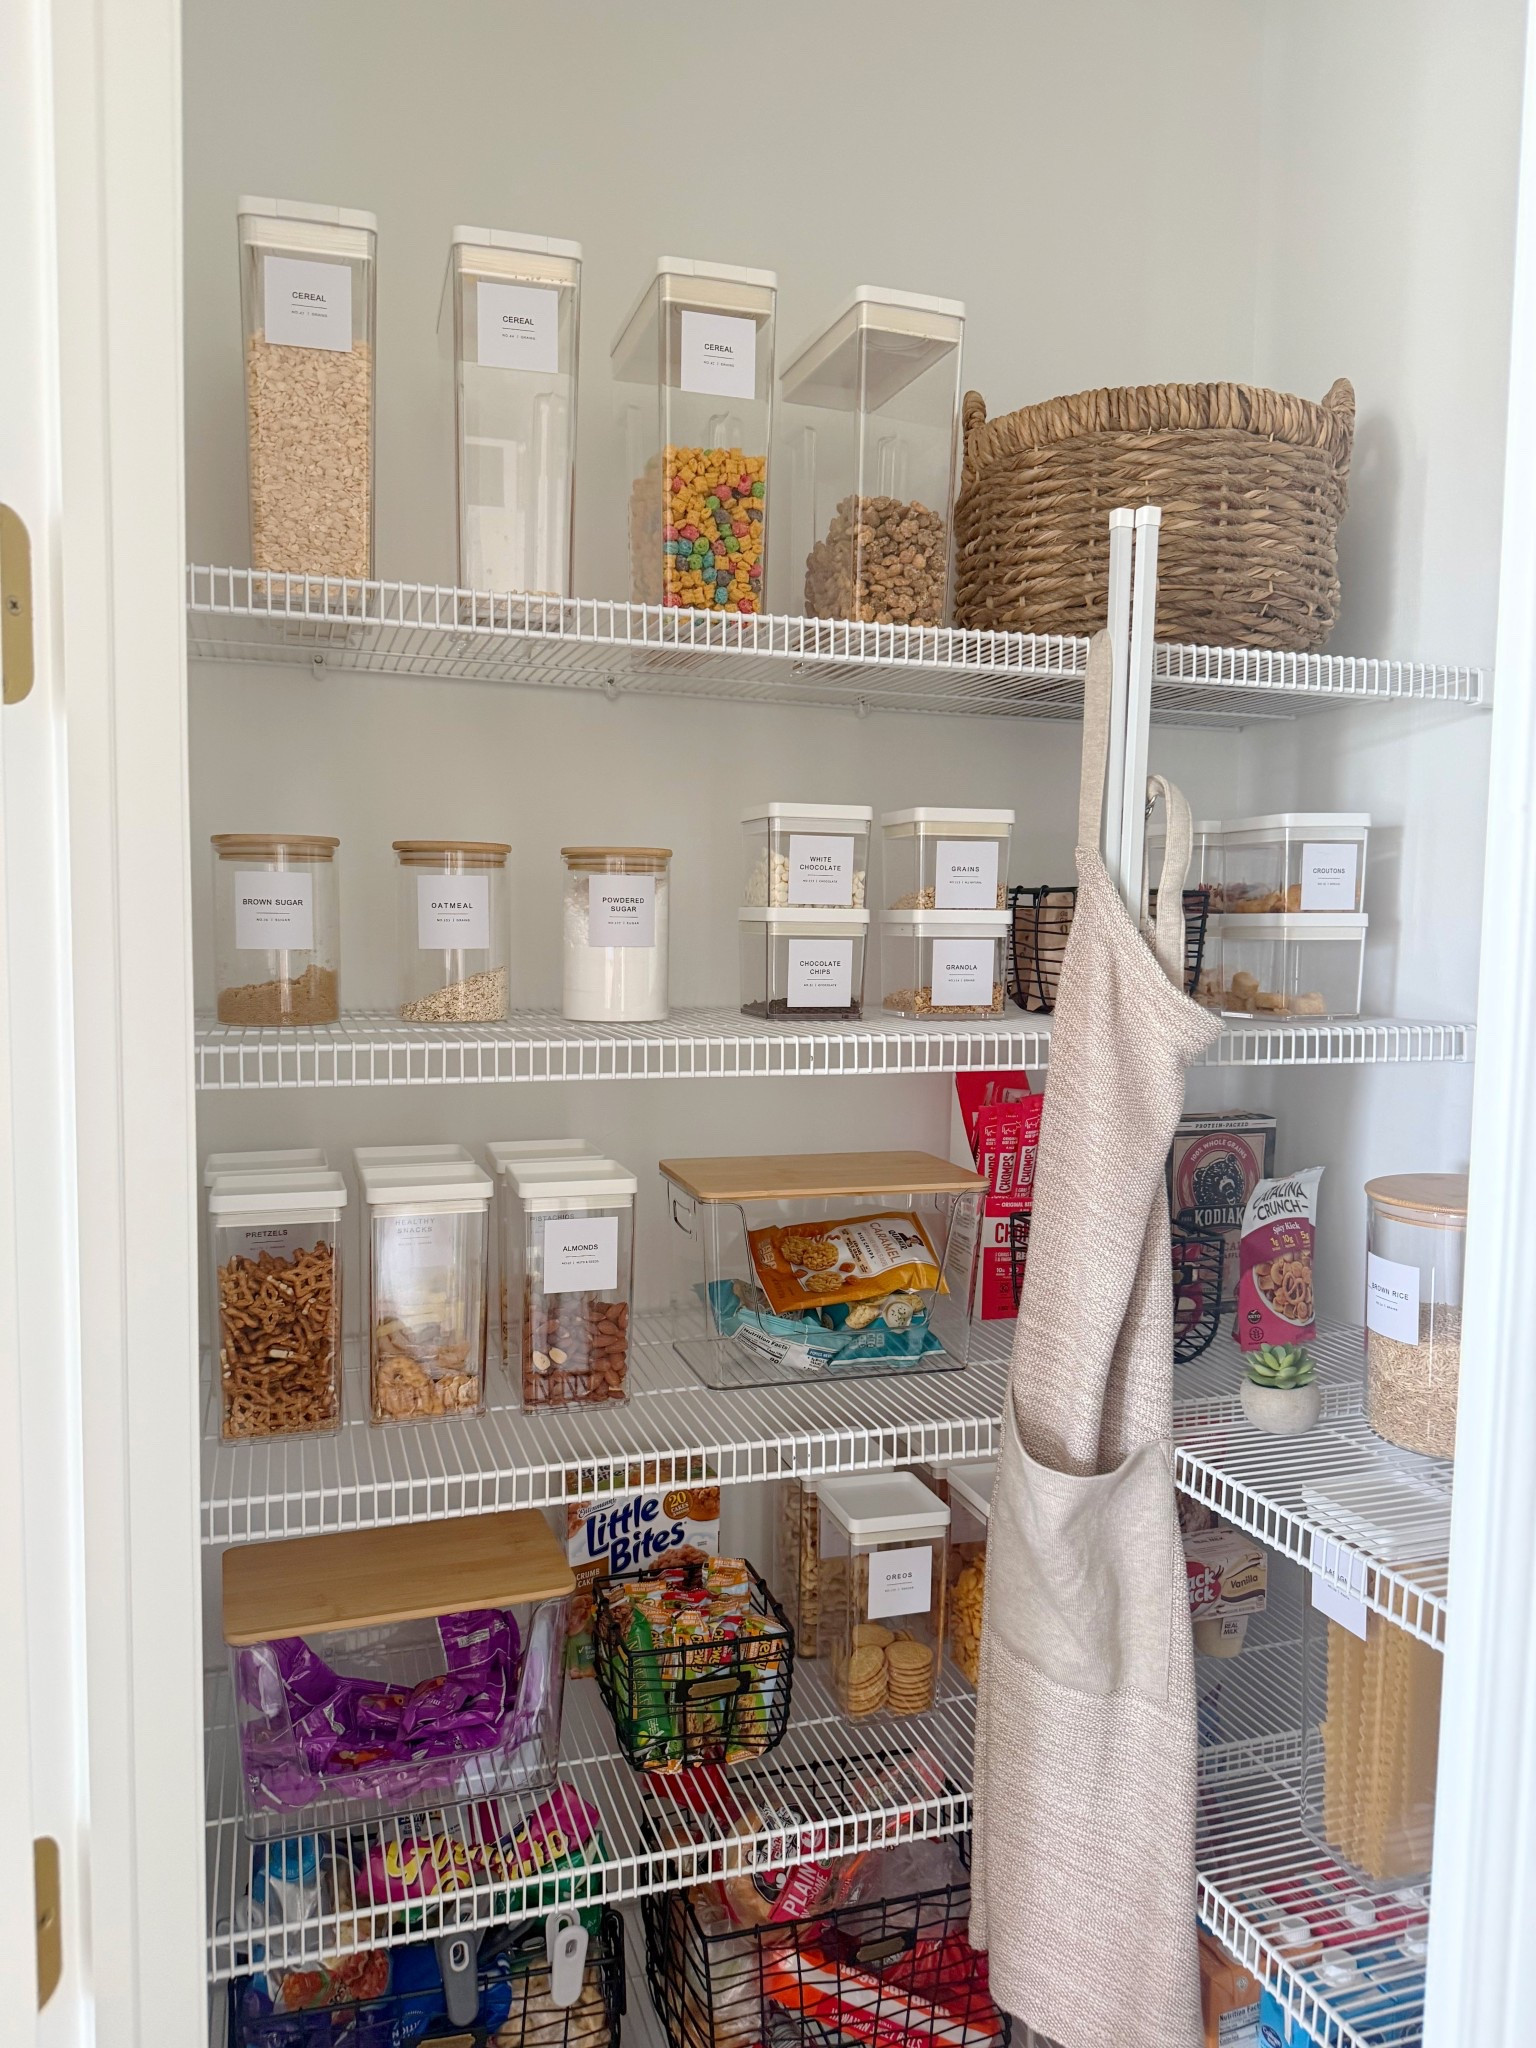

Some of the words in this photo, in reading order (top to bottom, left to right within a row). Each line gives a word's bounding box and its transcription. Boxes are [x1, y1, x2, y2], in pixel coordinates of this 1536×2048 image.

[291, 291, 327, 302] CEREAL
[502, 315, 535, 326] CEREAL
[704, 343, 734, 354] CEREAL
[799, 864, 842, 872] CHOCOLATE
[951, 865, 980, 873] GRAINS
[1312, 867, 1346, 875] CROUTONS
[242, 898, 272, 906] BROWN
[275, 898, 304, 906] SUGAR
[602, 896, 645, 904] POWDERED
[1202, 1139, 1226, 1150] WHOLE
[1226, 1140, 1248, 1160] GRAINS
[1020, 1147, 1036, 1184] CHOMPS
[998, 1155, 1015, 1192] CHOMPS
[1252, 1181, 1309, 1210] CATALINA
[1194, 1206, 1245, 1227] KODIAK
[1257, 1199, 1303, 1221] CRUNCH
[395, 1217, 436, 1226] HEALTHY
[1272, 1224, 1285, 1235] Spicy
[1284, 1221, 1301, 1230] Kick
[245, 1229, 288, 1238] PRETZELS
[397, 1226, 433, 1234] SNACKS
[562, 1243, 599, 1252] ALMONDS
[869, 1221, 901, 1263] CARAMEL
[1371, 1282, 1390, 1295] BROWN
[1392, 1290, 1409, 1301] RICE
[743, 1326, 771, 1345] Nutrition
[770, 1338, 789, 1351] Facts
[668, 1490, 688, 1508] 20
[671, 1502, 690, 1513] CAKES
[586, 1495, 660, 1558] Little
[610, 1521, 686, 1575] Bites
[576, 1568, 600, 1581] CRUMB
[885, 1571, 913, 1581] OREOS
[577, 1578, 594, 1588] CAK
[1230, 1574, 1259, 1589] Vanilla
[781, 1862, 817, 1917] PLAIN
[1219, 2007, 1246, 2021] Nutrition
